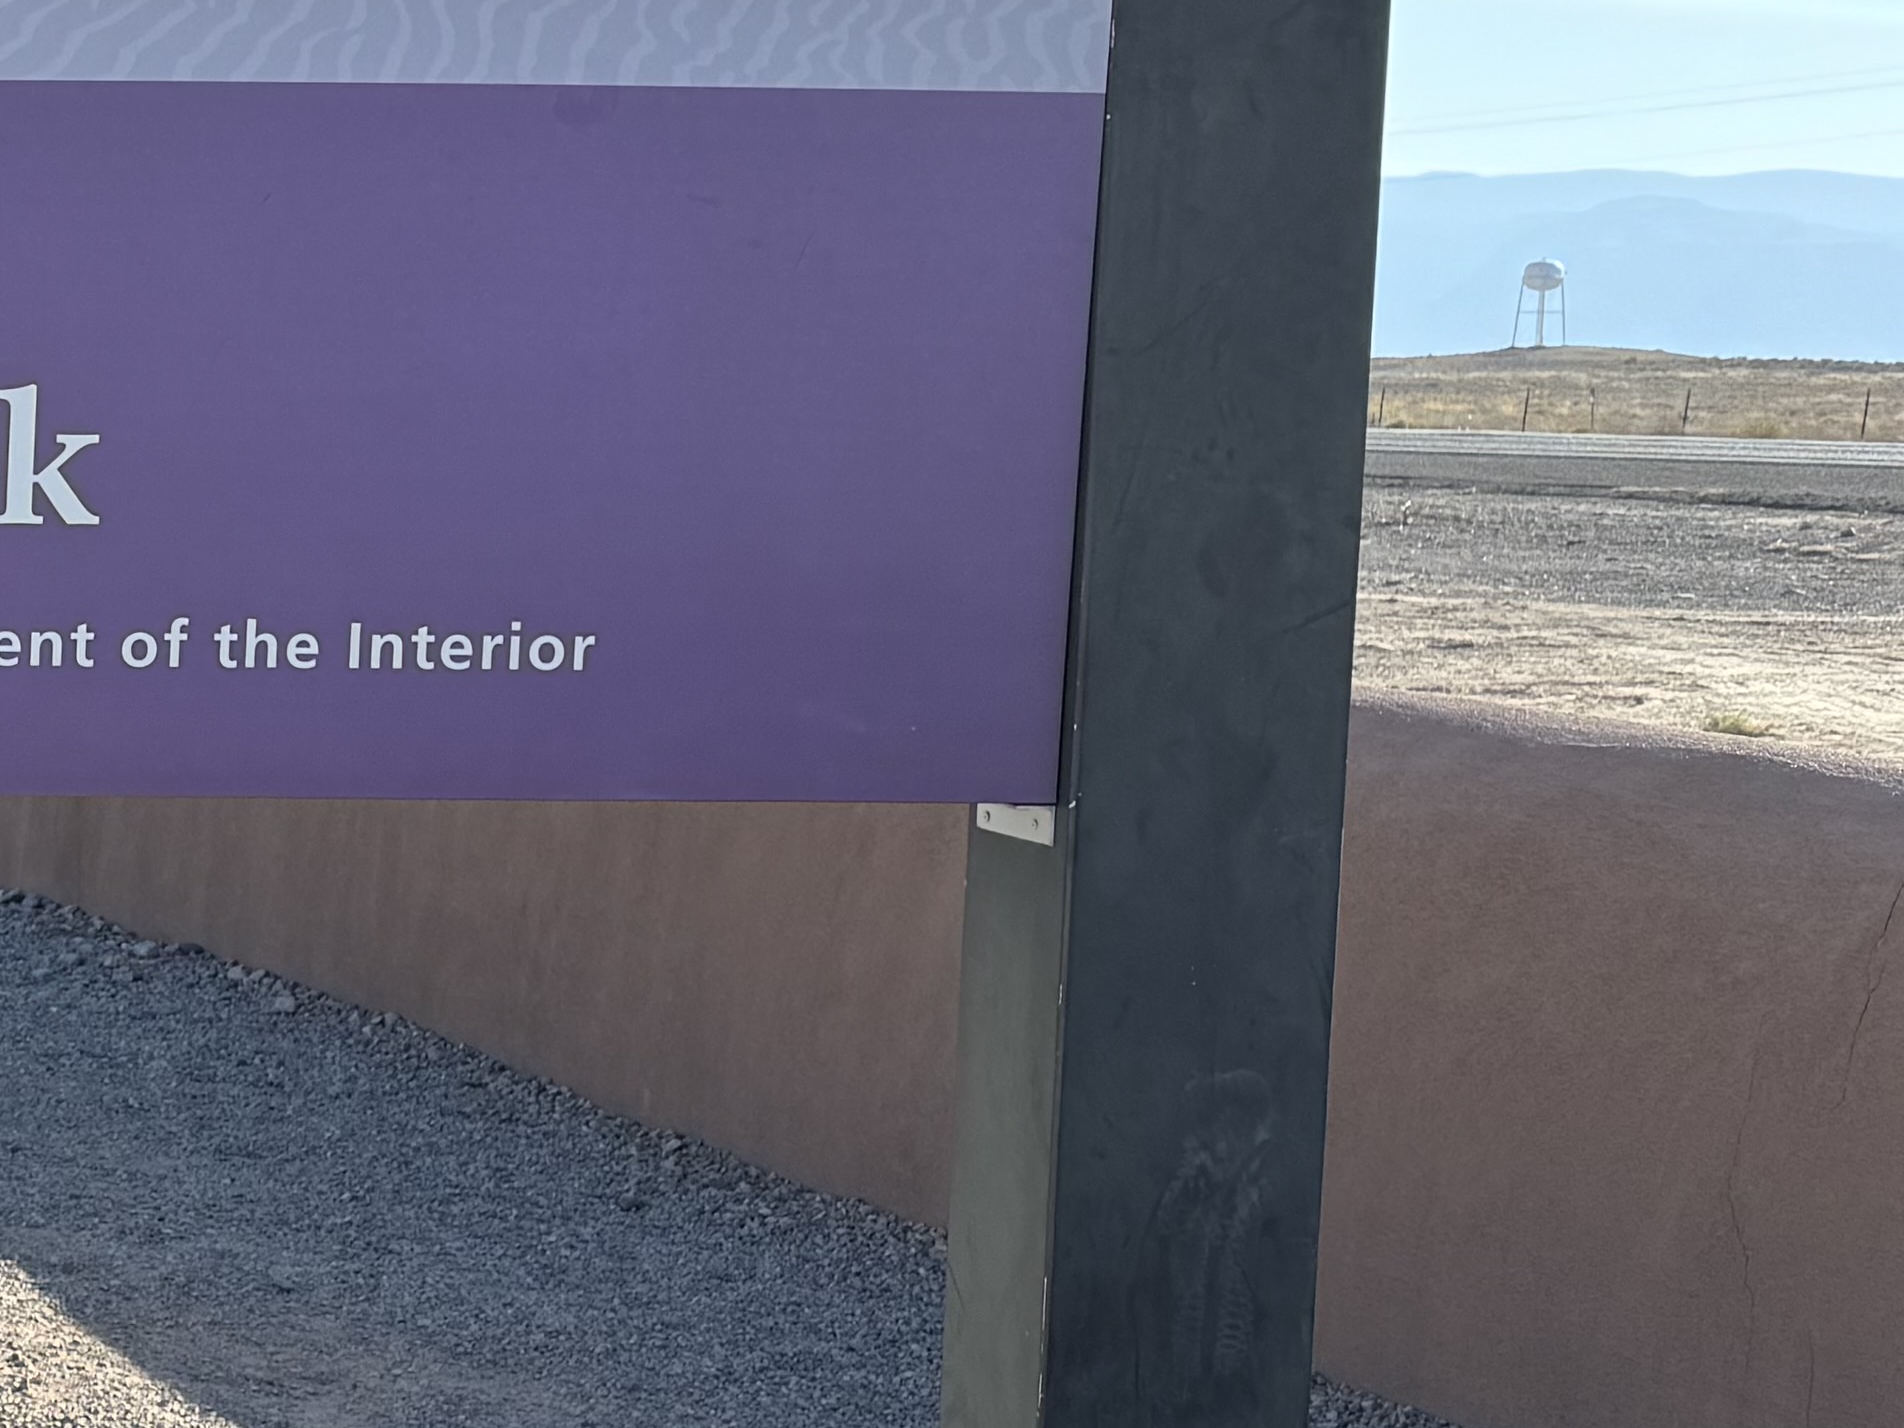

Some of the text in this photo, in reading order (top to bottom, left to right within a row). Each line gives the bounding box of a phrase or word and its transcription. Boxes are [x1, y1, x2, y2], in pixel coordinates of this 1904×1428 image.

[119, 615, 191, 670] of
[212, 617, 322, 671] the
[346, 620, 597, 673] Interior
